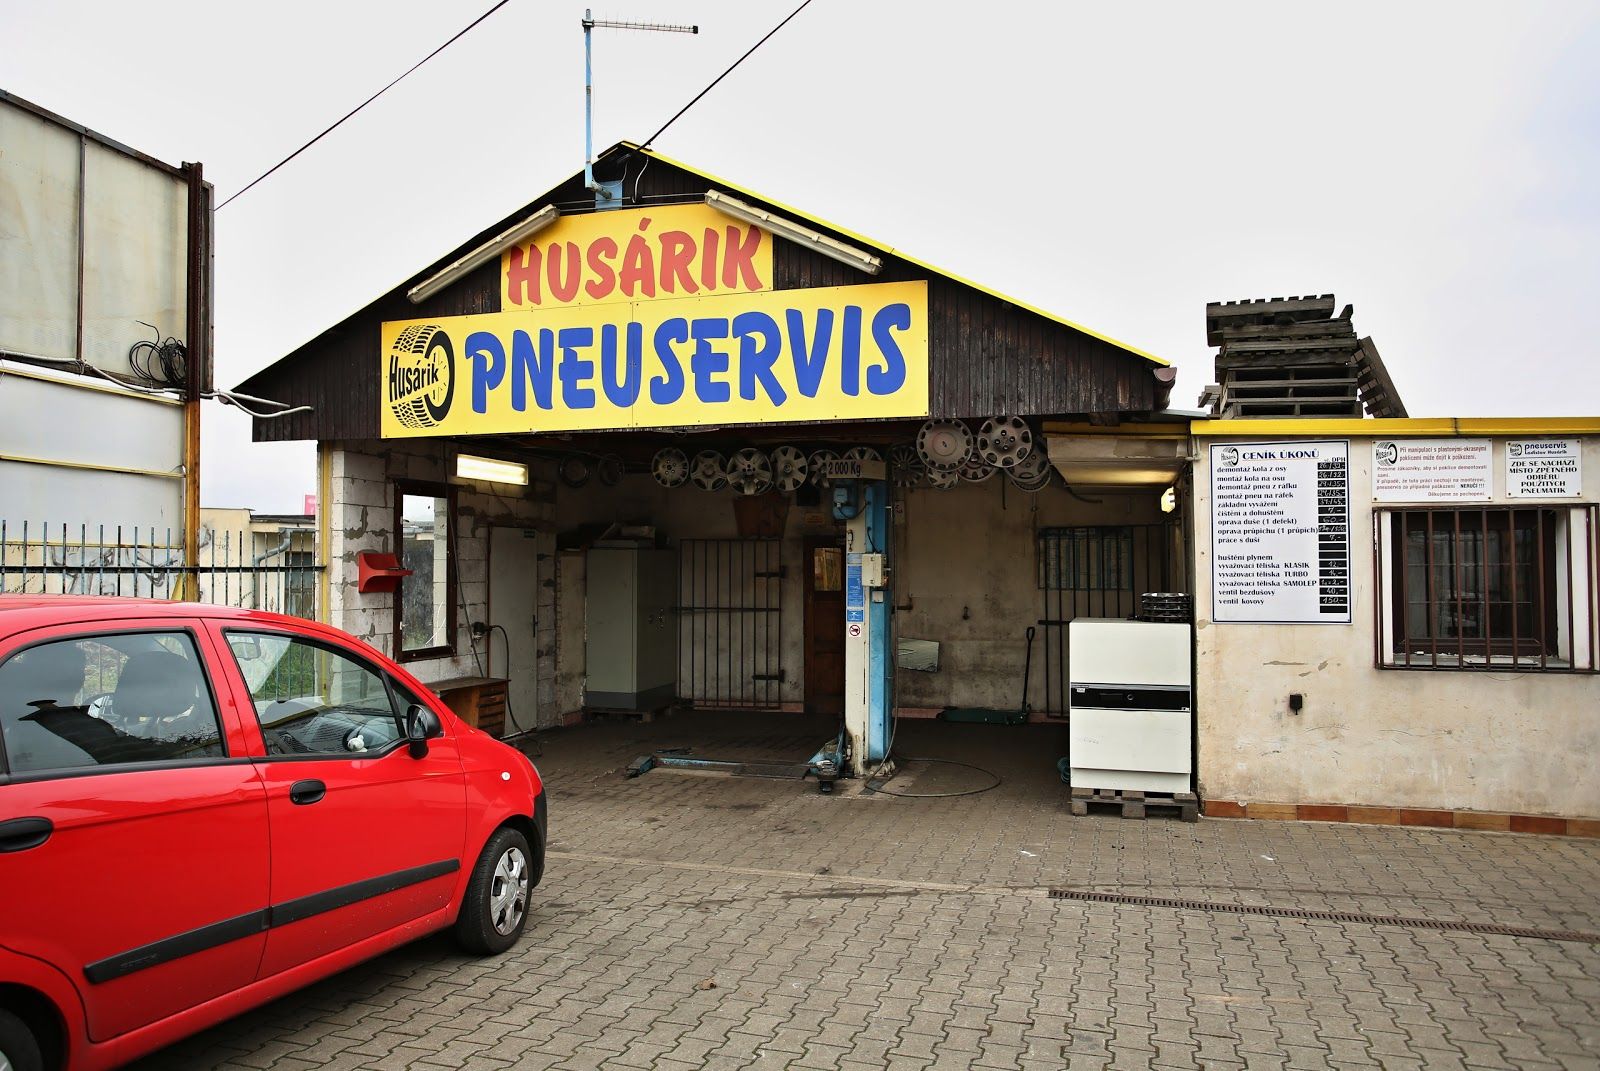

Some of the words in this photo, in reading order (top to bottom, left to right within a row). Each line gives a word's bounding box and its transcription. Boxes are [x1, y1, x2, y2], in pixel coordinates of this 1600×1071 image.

[507, 217, 763, 306] HUSÁRIK
[464, 303, 911, 415] PNEUSERVIS
[389, 354, 439, 403] Husárik
[1525, 441, 1567, 450] pneuservis
[1242, 450, 1276, 459] CENÍK
[1280, 448, 1320, 459] ÚKONŮ
[1376, 449, 1392, 460] Husárik
[828, 462, 833, 474] 2
[835, 462, 848, 474] 000
[851, 462, 861, 477] Kg
